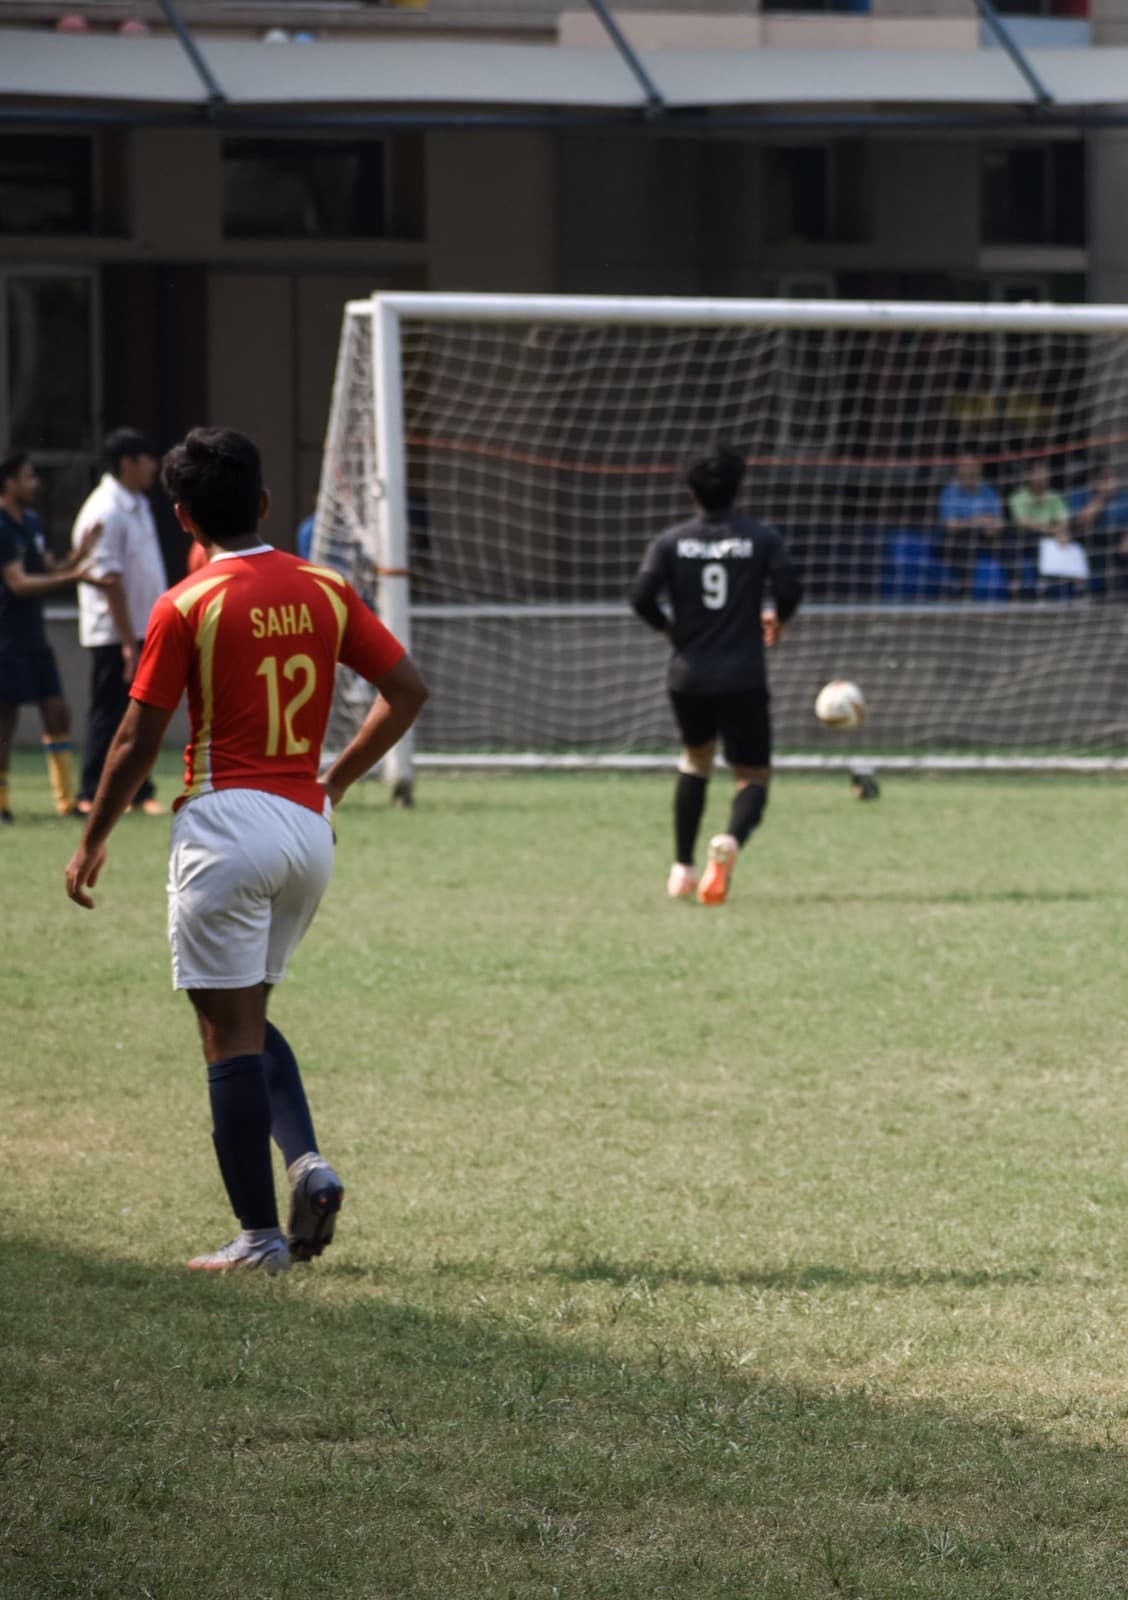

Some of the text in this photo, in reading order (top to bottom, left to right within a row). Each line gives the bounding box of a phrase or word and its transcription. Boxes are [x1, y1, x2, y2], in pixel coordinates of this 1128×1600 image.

[702, 563, 728, 610] 9
[250, 602, 314, 639] SAHA
[256, 653, 316, 757] 12
